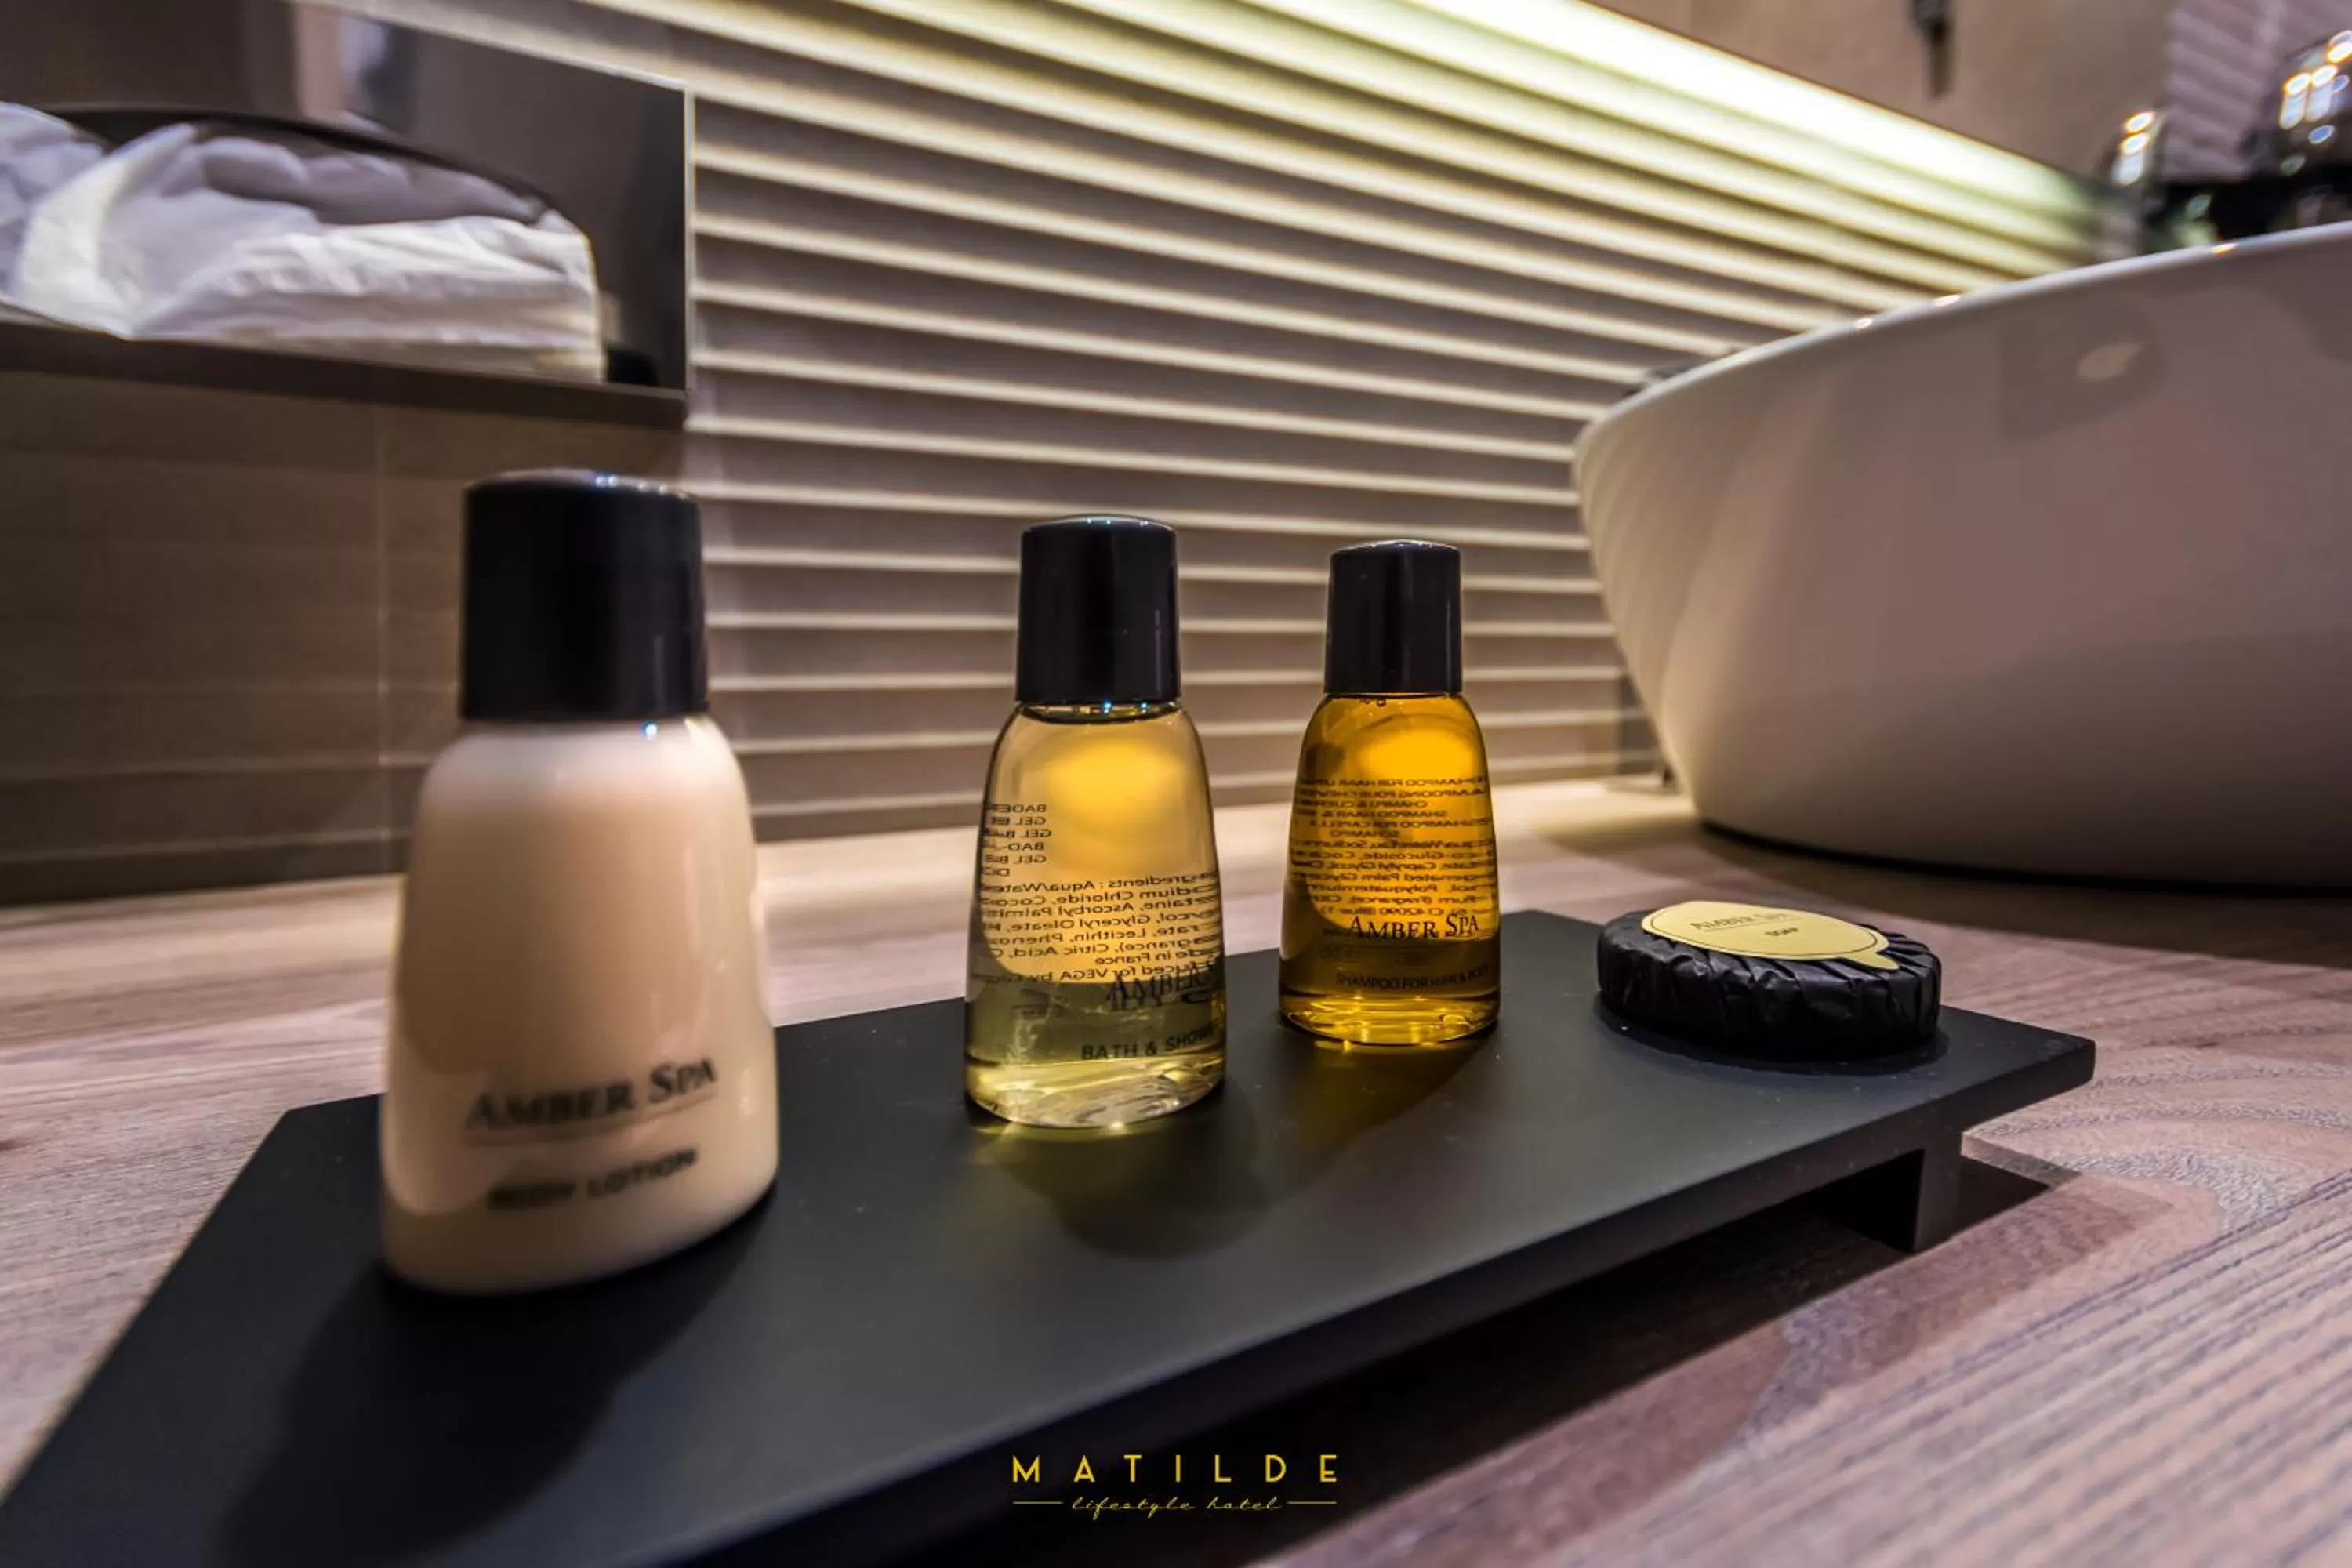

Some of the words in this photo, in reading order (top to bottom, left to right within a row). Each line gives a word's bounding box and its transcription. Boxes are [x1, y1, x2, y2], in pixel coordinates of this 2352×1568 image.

[1350, 915, 1439, 939] AMBER
[1445, 913, 1480, 938] SPA
[1081, 1044, 1137, 1059] BATH
[1145, 1041, 1156, 1055] &
[466, 1080, 633, 1131] AMBER
[648, 1058, 717, 1104] SPA
